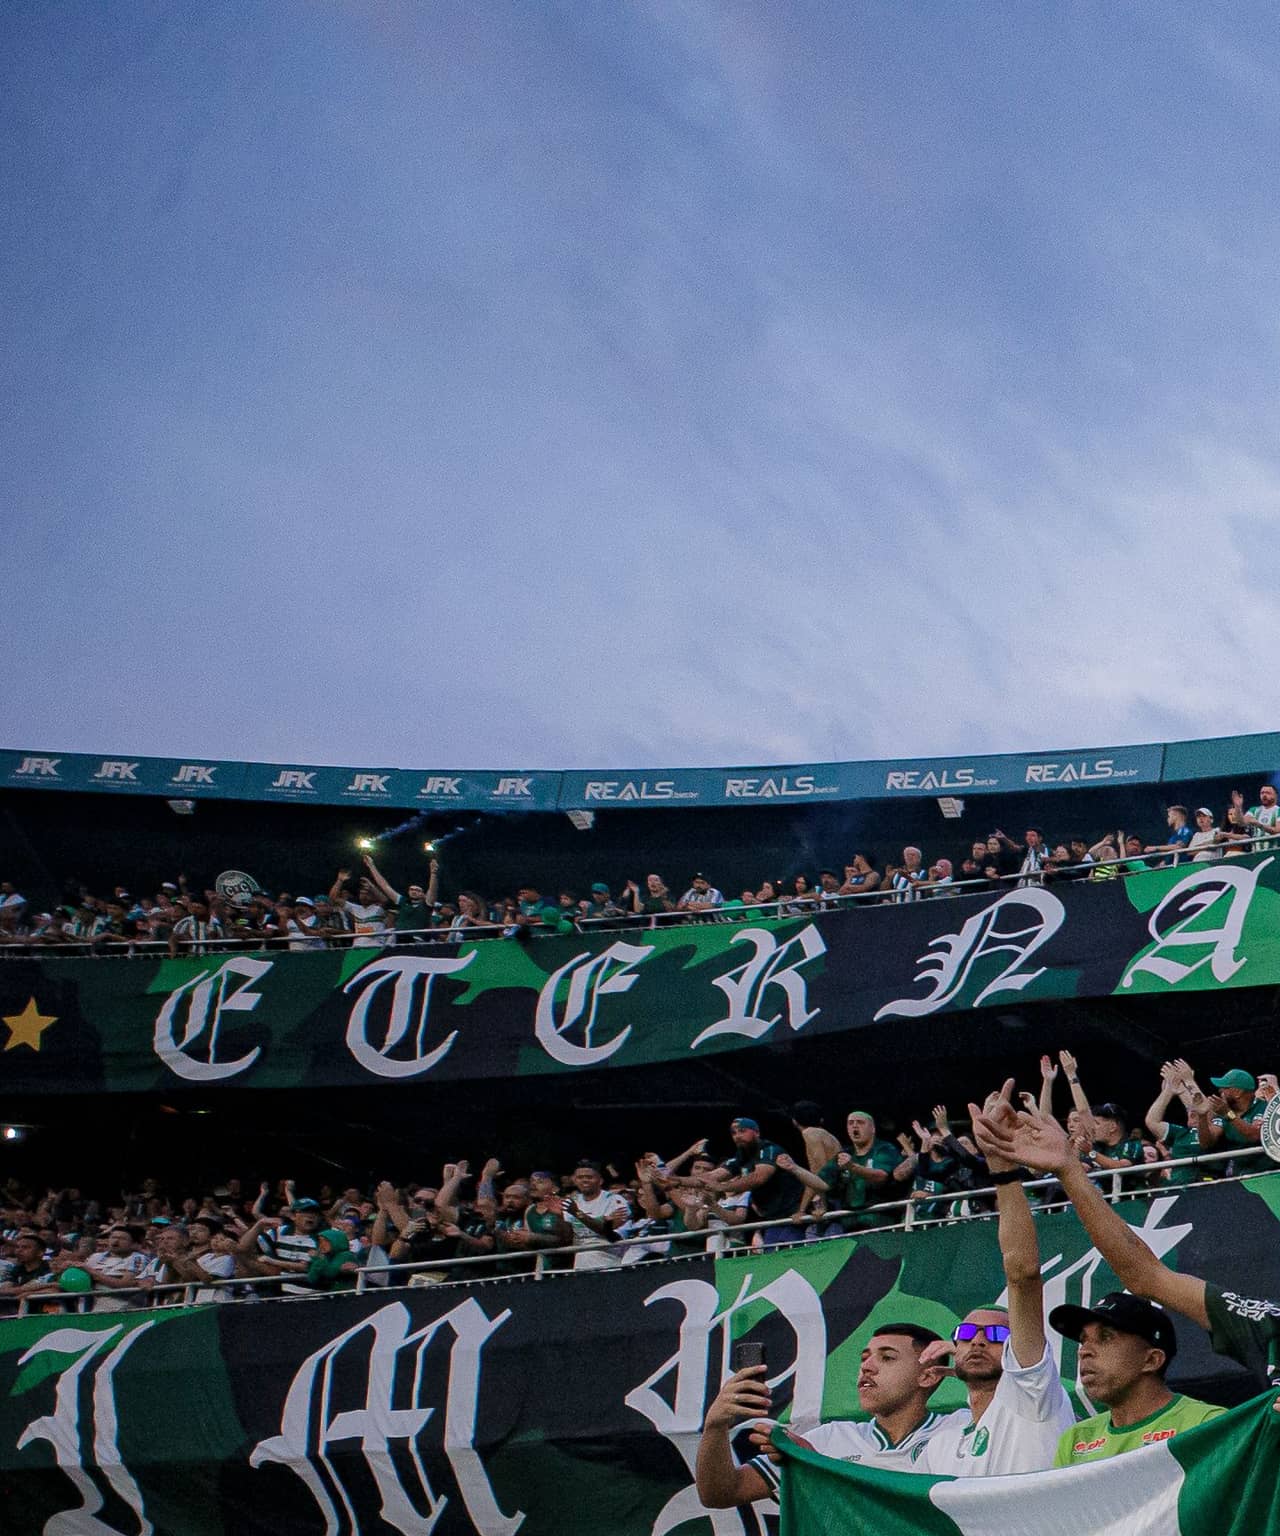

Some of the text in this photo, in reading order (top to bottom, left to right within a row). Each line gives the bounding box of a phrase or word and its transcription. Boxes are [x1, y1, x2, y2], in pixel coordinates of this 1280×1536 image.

[15, 757, 62, 777] JFK
[94, 761, 140, 781] JFK
[172, 765, 217, 785] JFK
[1025, 760, 1114, 784] REALS
[271, 770, 319, 790] JFK
[347, 774, 392, 793] JFK
[419, 776, 464, 795] JFK
[491, 777, 535, 796] JFK
[725, 776, 815, 798] REALS
[886, 768, 975, 791] REALS
[584, 781, 675, 801] REALS
